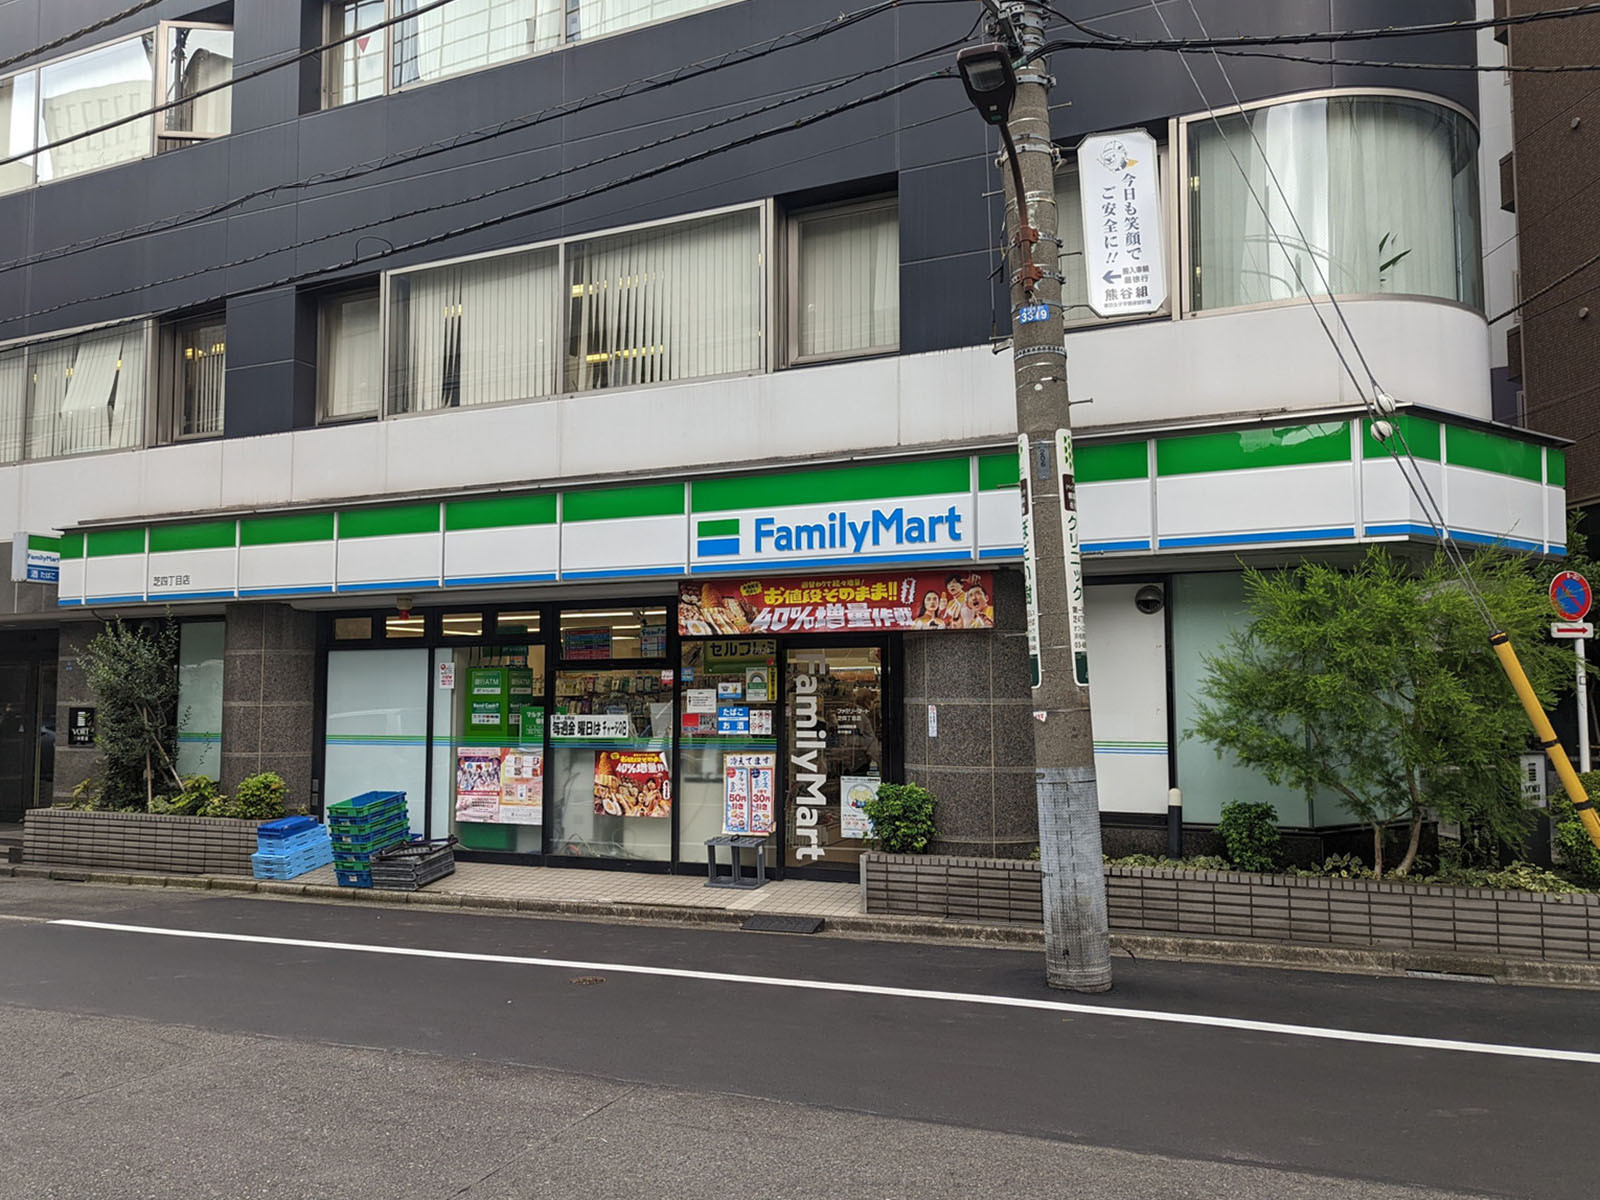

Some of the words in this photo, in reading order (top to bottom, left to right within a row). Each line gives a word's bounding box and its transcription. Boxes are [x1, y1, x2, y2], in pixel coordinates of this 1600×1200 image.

[1122, 172, 1142, 261] 今日も笑顔で
[1105, 285, 1149, 302] 熊谷組
[755, 505, 962, 553] FamilyMart
[1066, 515, 1084, 601] クリニック
[41, 570, 56, 579] たばこ
[153, 575, 190, 587] 芝四丁目店
[764, 581, 898, 605] お値段そのまま!!
[751, 603, 915, 631] 40%増量作戦
[723, 708, 744, 716] たばこ
[577, 720, 601, 736] 曜日は
[602, 720, 627, 736] チャージの日
[722, 721, 745, 730] お酒
[730, 756, 770, 766] 冷えてます
[791, 654, 827, 861] FamilyMart
[761, 771, 769, 789] アイス
[729, 793, 746, 802] 50円
[753, 794, 770, 803] 30円
